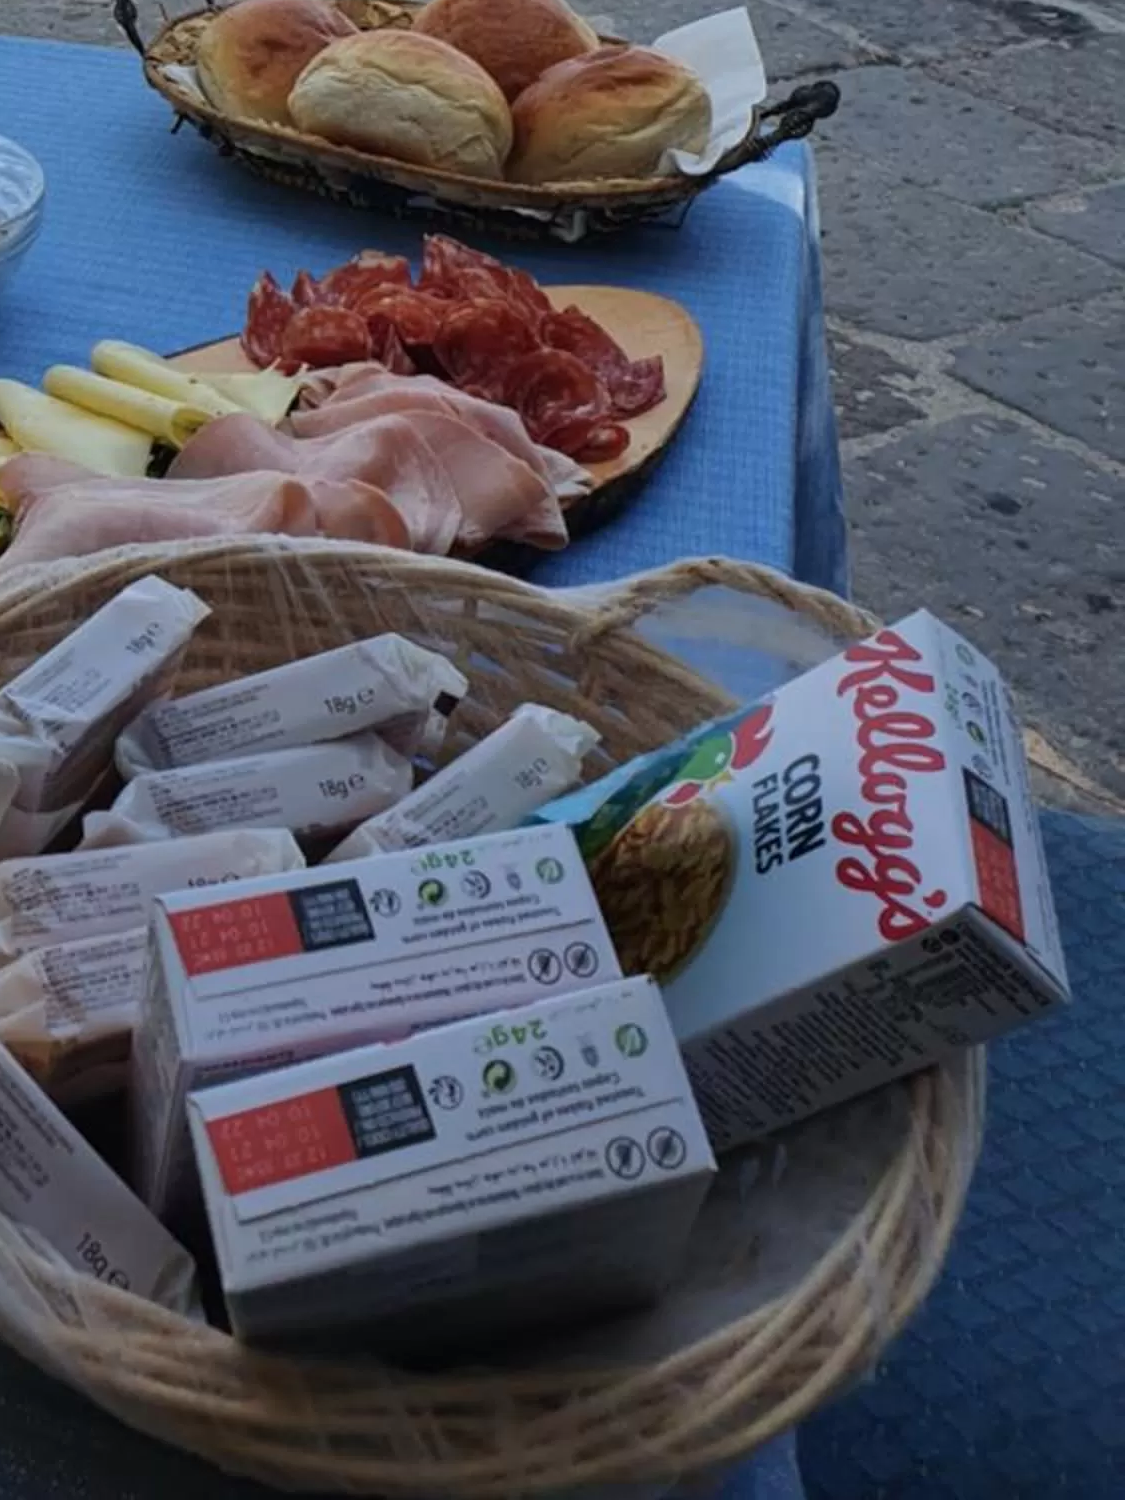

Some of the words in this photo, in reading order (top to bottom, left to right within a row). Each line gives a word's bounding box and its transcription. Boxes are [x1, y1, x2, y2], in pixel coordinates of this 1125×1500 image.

[751, 773, 784, 876] FLAKES
[782, 753, 827, 861] CORN
[831, 629, 947, 942] Kellogg's
